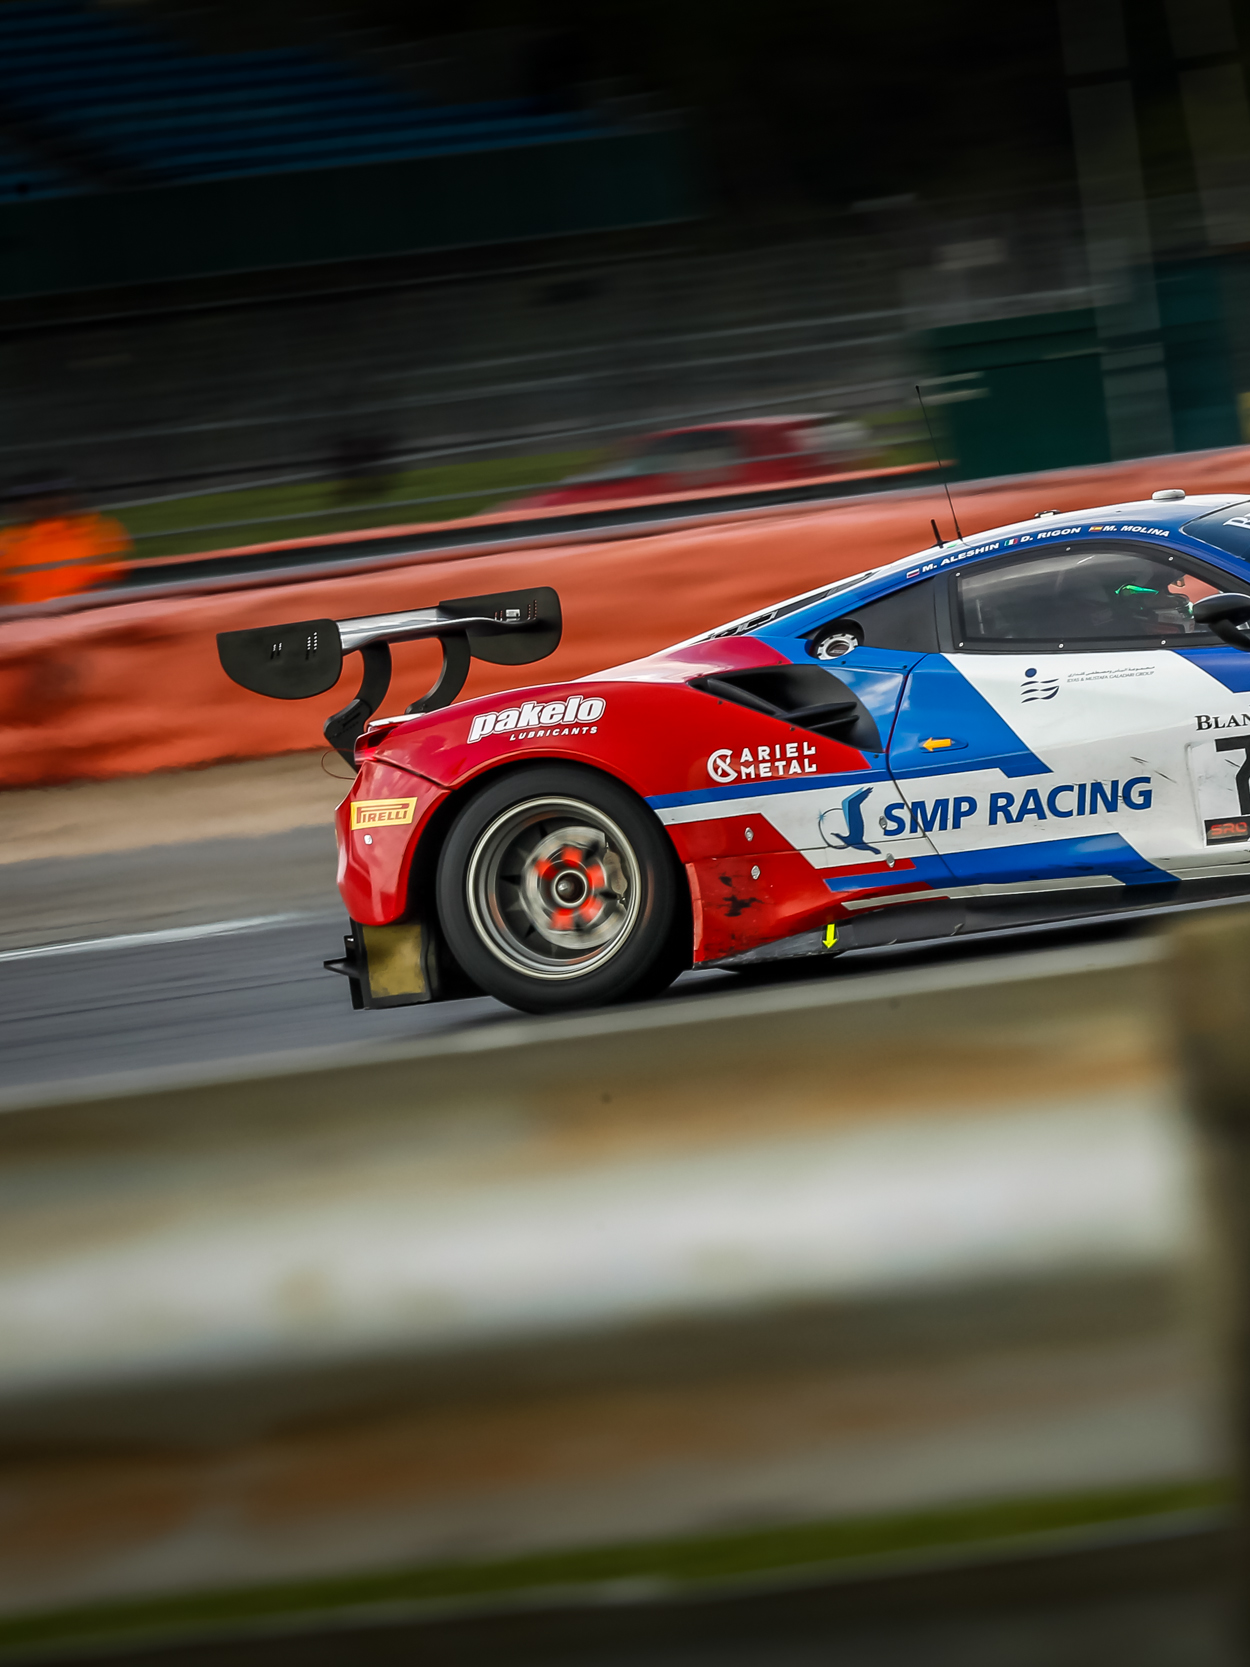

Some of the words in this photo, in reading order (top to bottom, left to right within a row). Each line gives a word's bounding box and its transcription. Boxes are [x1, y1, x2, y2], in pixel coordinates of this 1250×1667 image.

[922, 563, 938, 572] M.
[940, 543, 999, 566] ALESHIN
[1020, 535, 1034, 543] D.
[1037, 527, 1082, 539] RIGON
[1121, 525, 1170, 537] MOLINA
[467, 696, 606, 744] pakelo
[509, 727, 598, 741] LUBRICANTS
[740, 741, 816, 763] ARIEL
[740, 758, 817, 779] METAL
[356, 803, 410, 824] PIRELLI
[882, 796, 978, 836] SMP
[988, 776, 1152, 826] RACING
[1210, 821, 1248, 836] SRO
